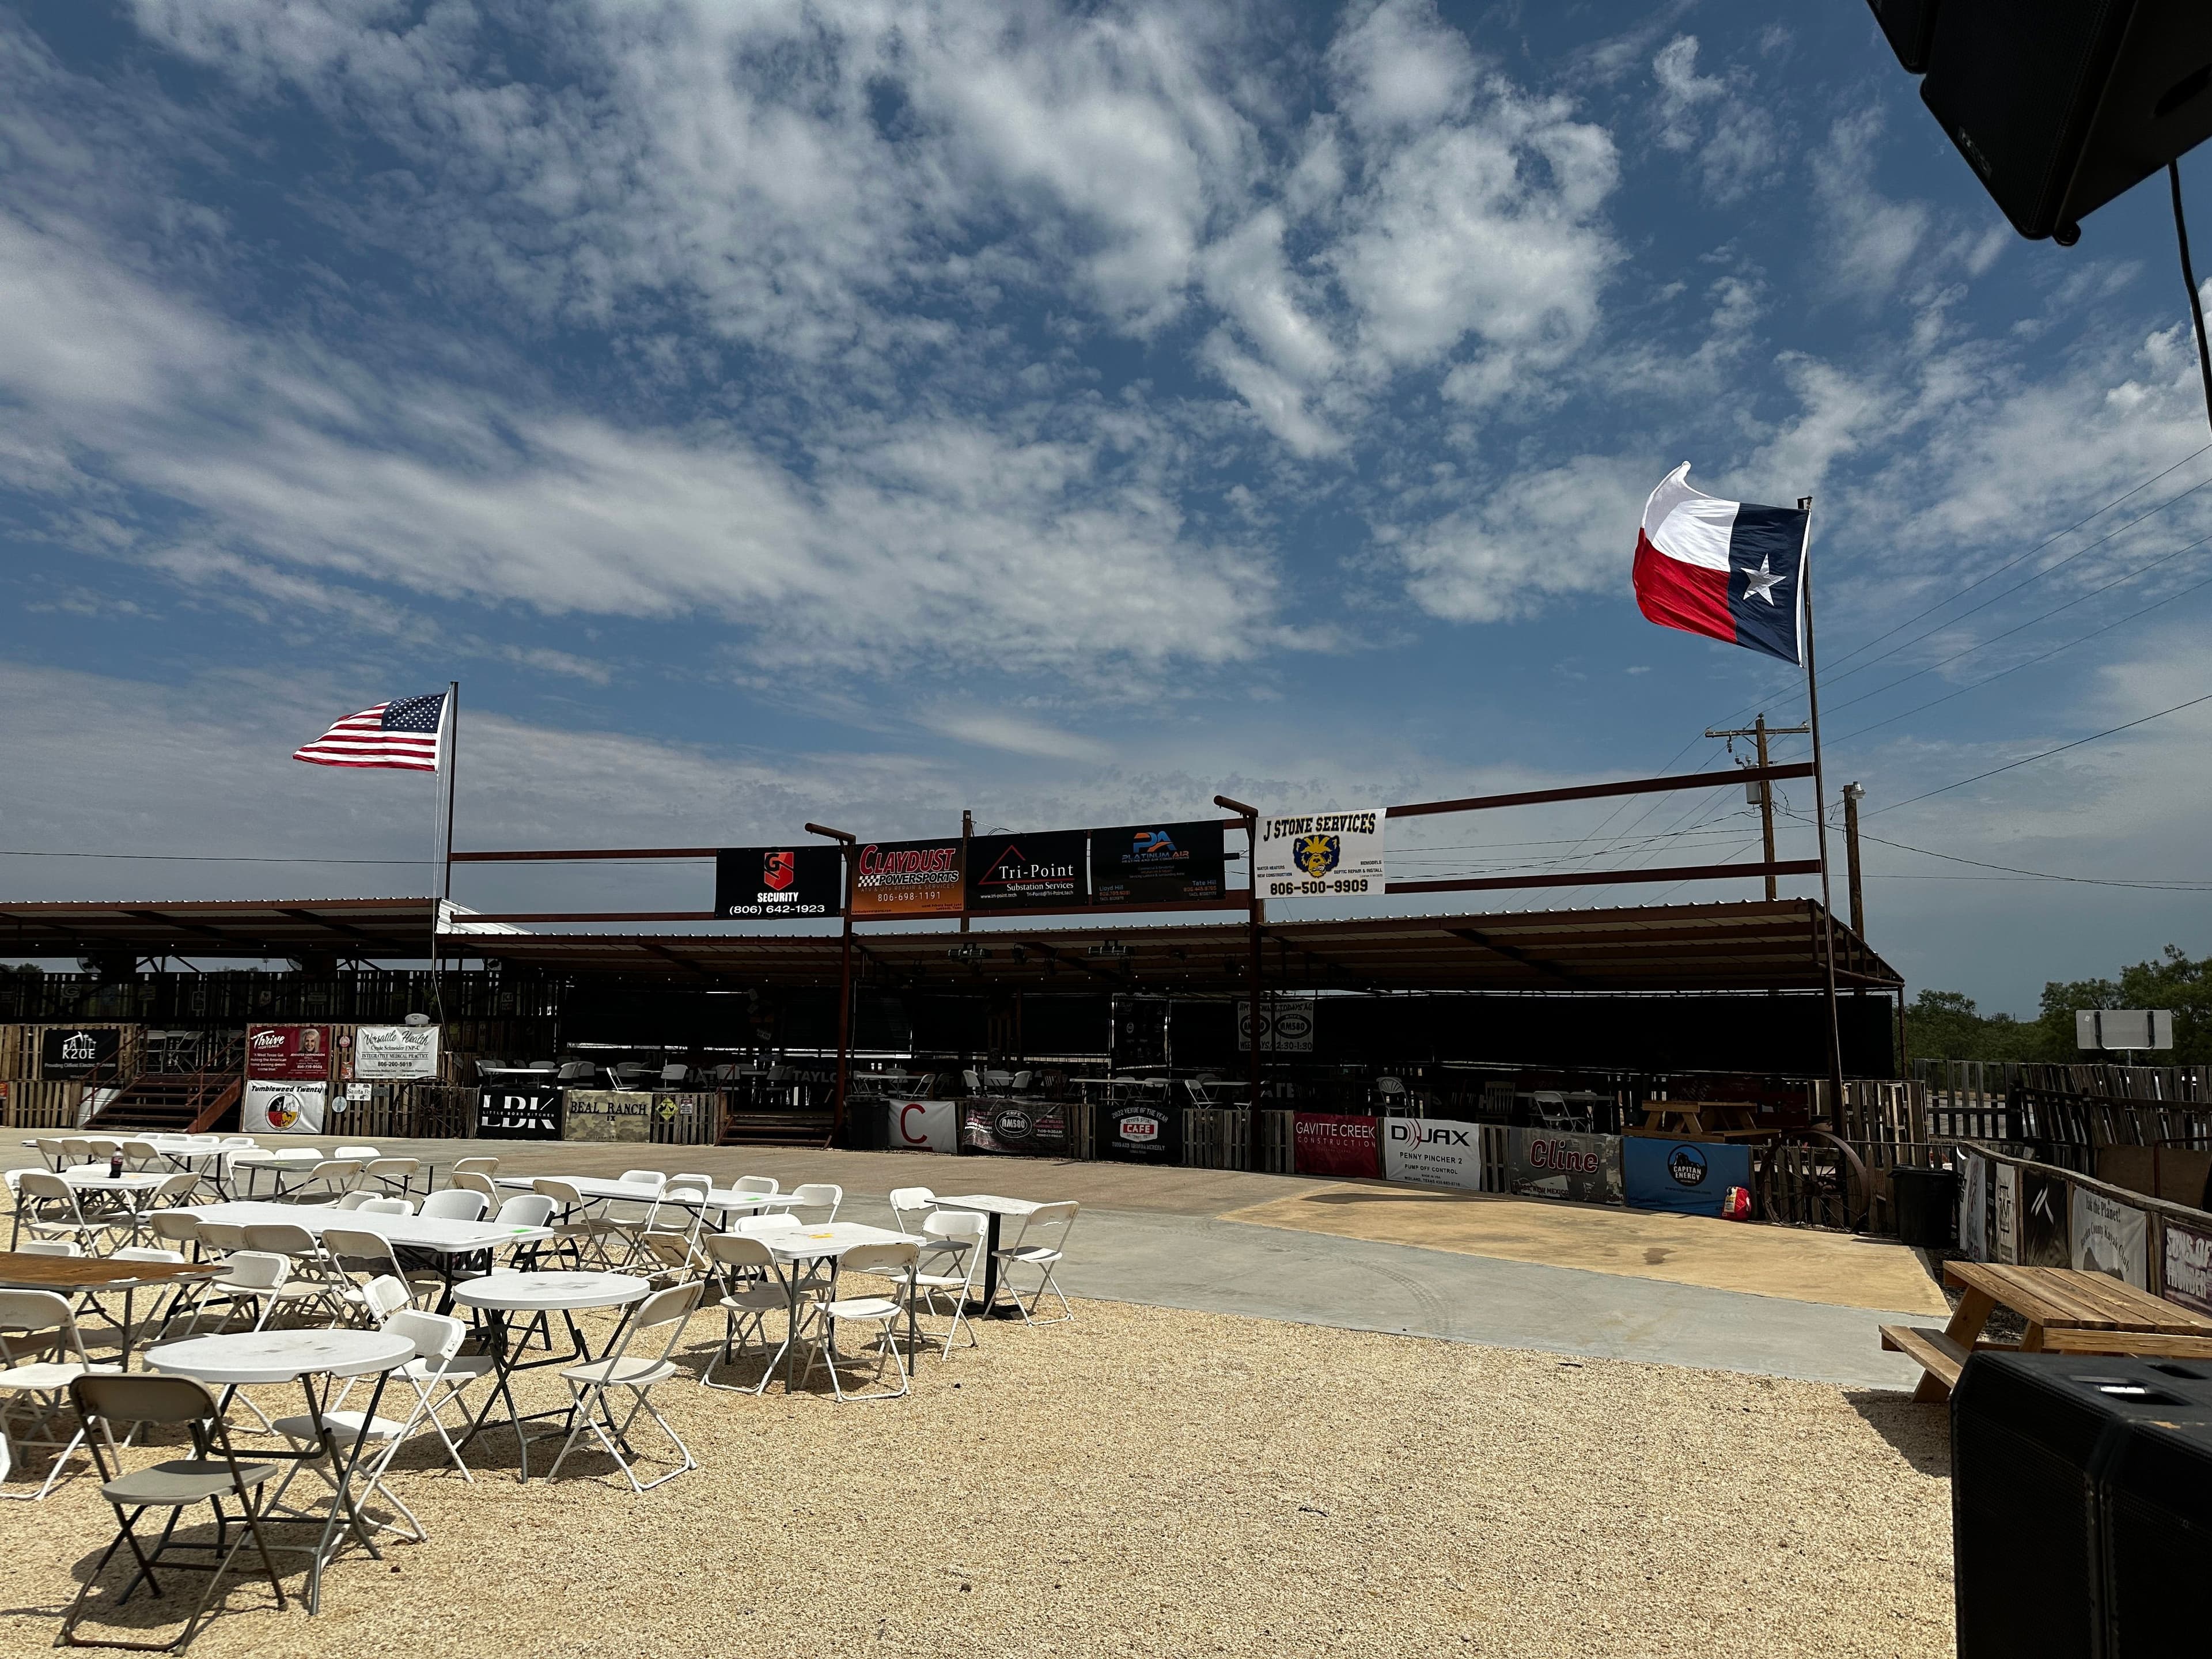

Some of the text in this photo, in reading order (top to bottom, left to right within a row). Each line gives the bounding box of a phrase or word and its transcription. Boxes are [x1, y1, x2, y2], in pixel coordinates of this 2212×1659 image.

[1264, 813, 1376, 842] J STONE SERVICES
[859, 844, 956, 876] CLAYDUST
[1122, 852, 1169, 861] PLATINUM
[999, 863, 1074, 878] Tri-Point
[878, 870, 959, 886] POWERSPORTS
[1007, 881, 1074, 892] Substation Services
[1270, 879, 1368, 895] 806-500-9909
[757, 892, 798, 903] SECURITY
[877, 891, 941, 902] 806-698-1191
[729, 903, 825, 915] (806) 642-1923
[251, 1030, 285, 1050] Thrive
[364, 1029, 429, 1046] Versatile Health
[570, 1101, 599, 1113] BEAL
[607, 1102, 647, 1115] RANCH
[1112, 1109, 1124, 1119] 2022
[1146, 1108, 1156, 1116] THE
[1002, 1119, 1025, 1129] AM580
[1127, 1124, 1150, 1134] CAFE
[1296, 1122, 1375, 1139] GAVITTE CREEK
[1297, 1136, 1376, 1148] CONSTRUCTION
[1400, 1152, 1422, 1161] PENNY
[1424, 1154, 1456, 1164] PINCHER
[1529, 1139, 1599, 1173] Cline
[1432, 1166, 1458, 1175] CONTROL
[1673, 1166, 1702, 1175] CAPITAN
[1675, 1172, 1700, 1181] ENERGY
[1547, 1187, 1570, 1196] MEXICO
[2101, 1201, 2121, 1223] Planet!
[2090, 1222, 2130, 1272] County Kayak Club
